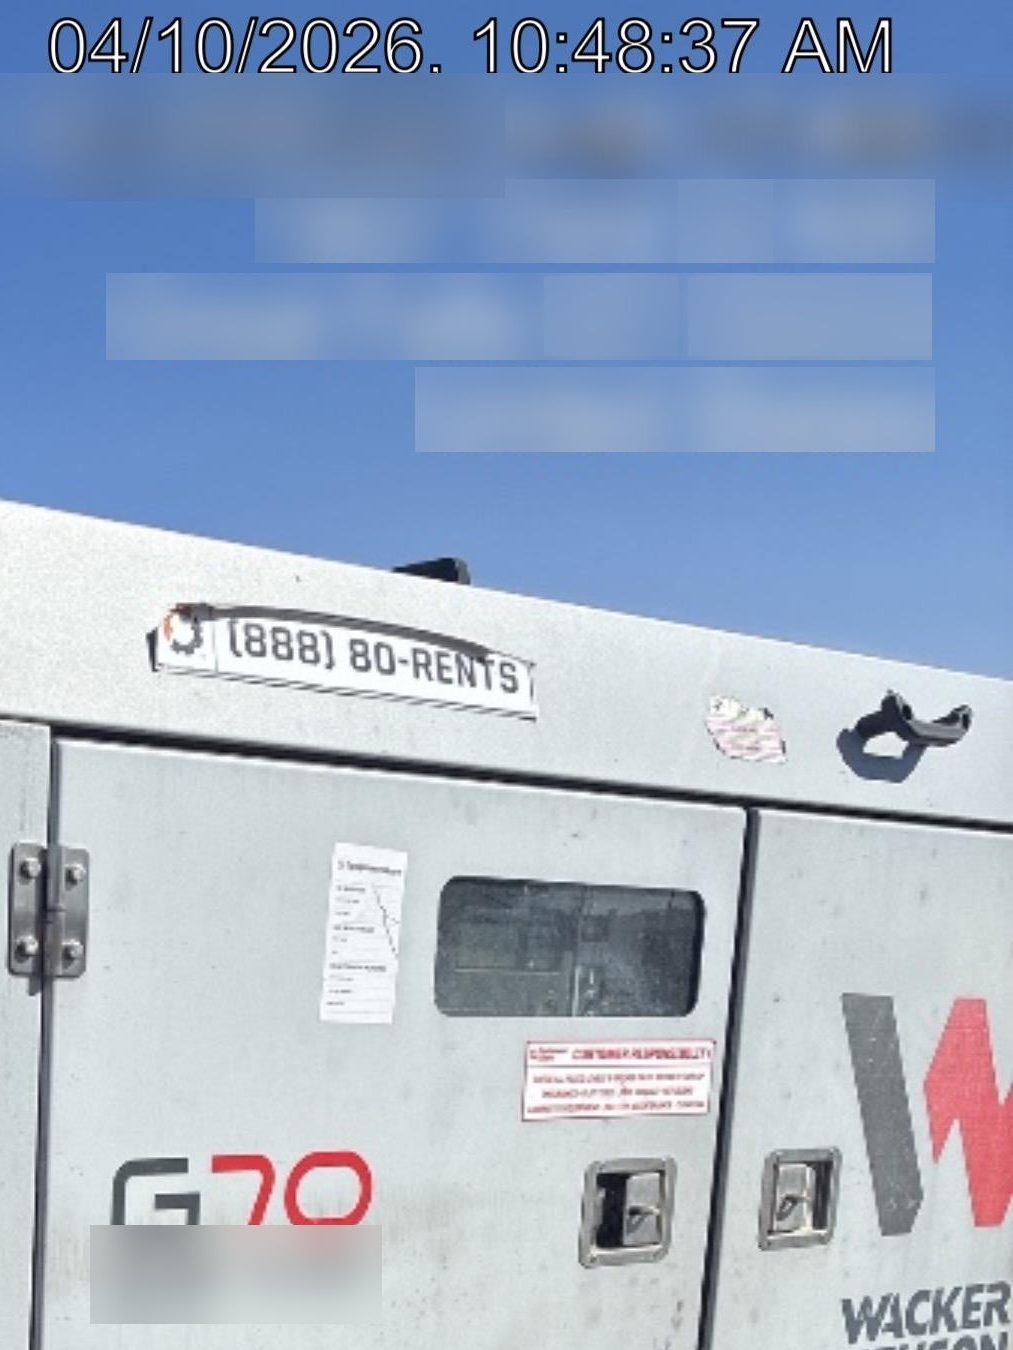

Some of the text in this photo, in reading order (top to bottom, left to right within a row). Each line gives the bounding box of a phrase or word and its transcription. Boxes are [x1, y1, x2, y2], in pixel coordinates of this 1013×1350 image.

[228, 617, 520, 695] (888) 80-RENTS
[110, 1151, 373, 1226] G70
[841, 1281, 1012, 1345] WACKER
